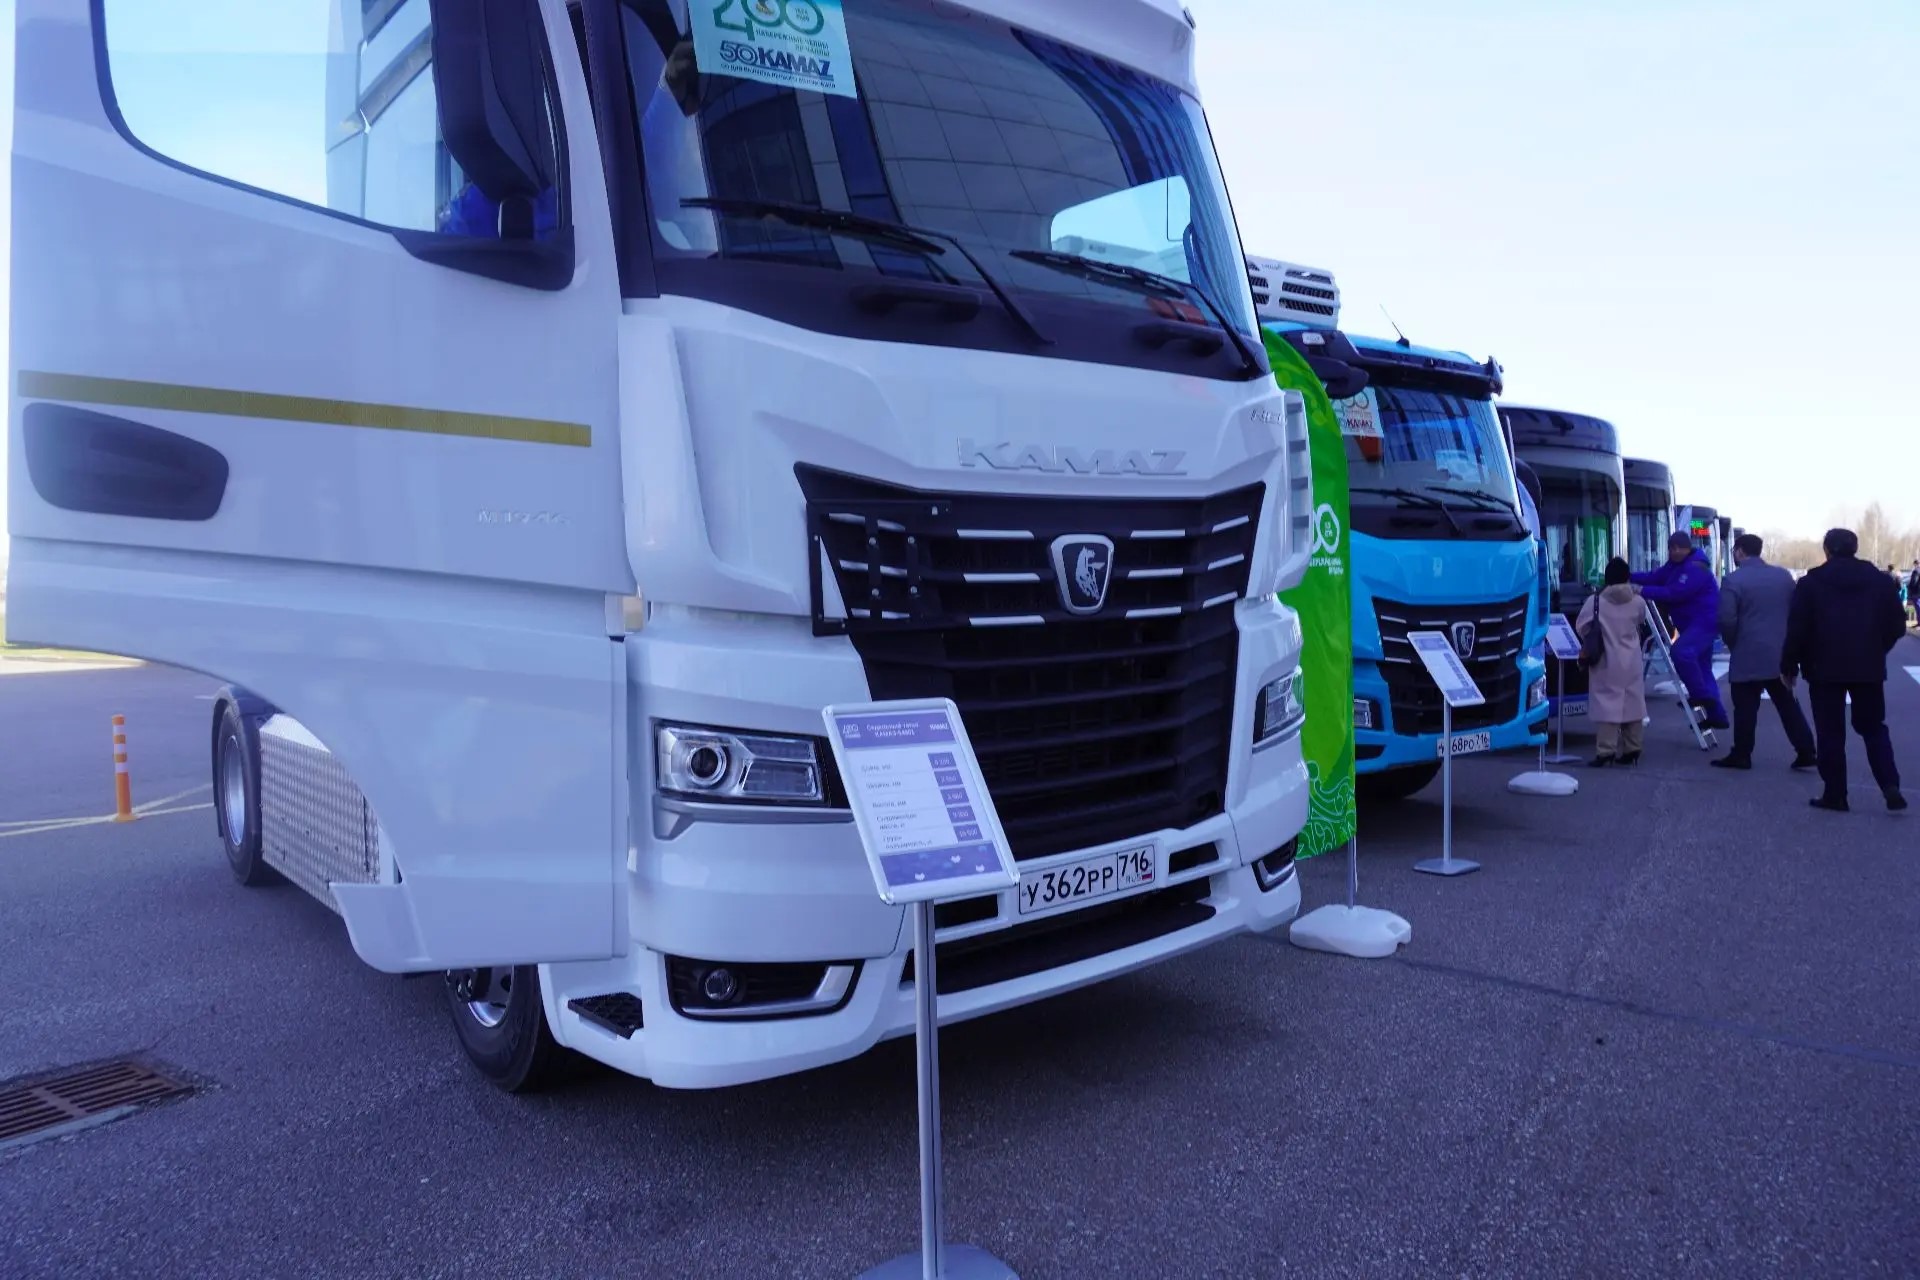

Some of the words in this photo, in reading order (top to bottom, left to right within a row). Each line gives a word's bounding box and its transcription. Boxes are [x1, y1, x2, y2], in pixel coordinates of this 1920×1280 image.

[957, 436, 1188, 476] KAMAZ
[1027, 866, 1114, 907] У362РР
[1118, 850, 1149, 877] 716
